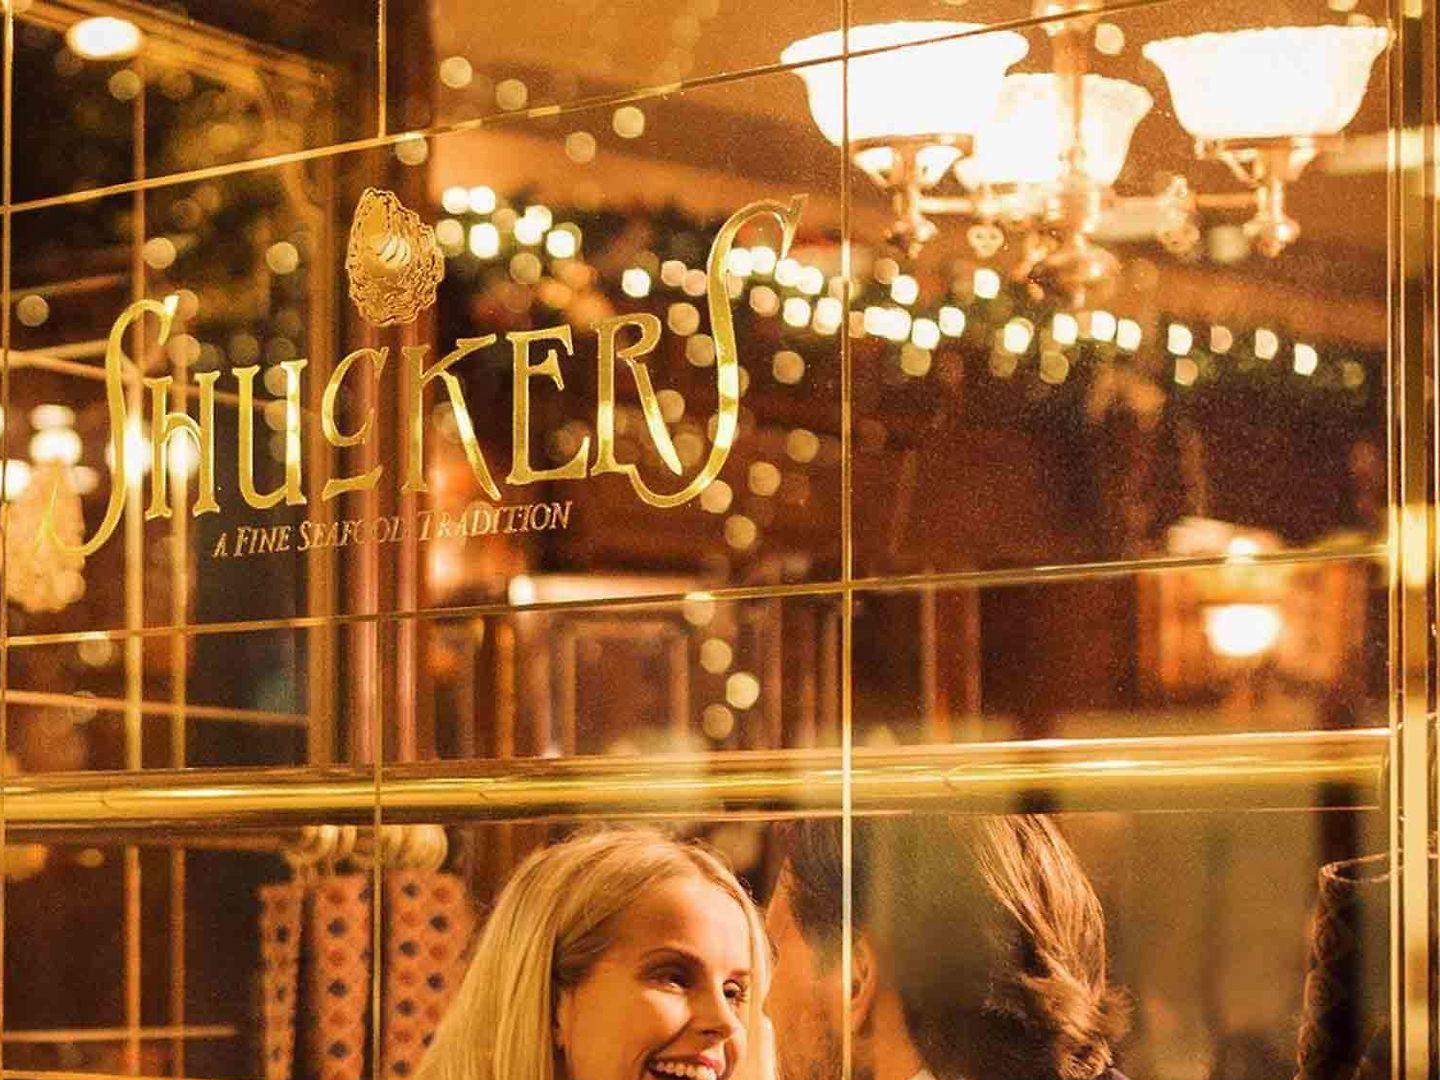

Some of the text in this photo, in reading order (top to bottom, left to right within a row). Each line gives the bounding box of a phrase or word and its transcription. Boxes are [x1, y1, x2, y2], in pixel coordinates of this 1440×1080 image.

[34, 193, 807, 556] SHUCKERS
[212, 501, 573, 557] A FINE SEAFOOD TRADITION
